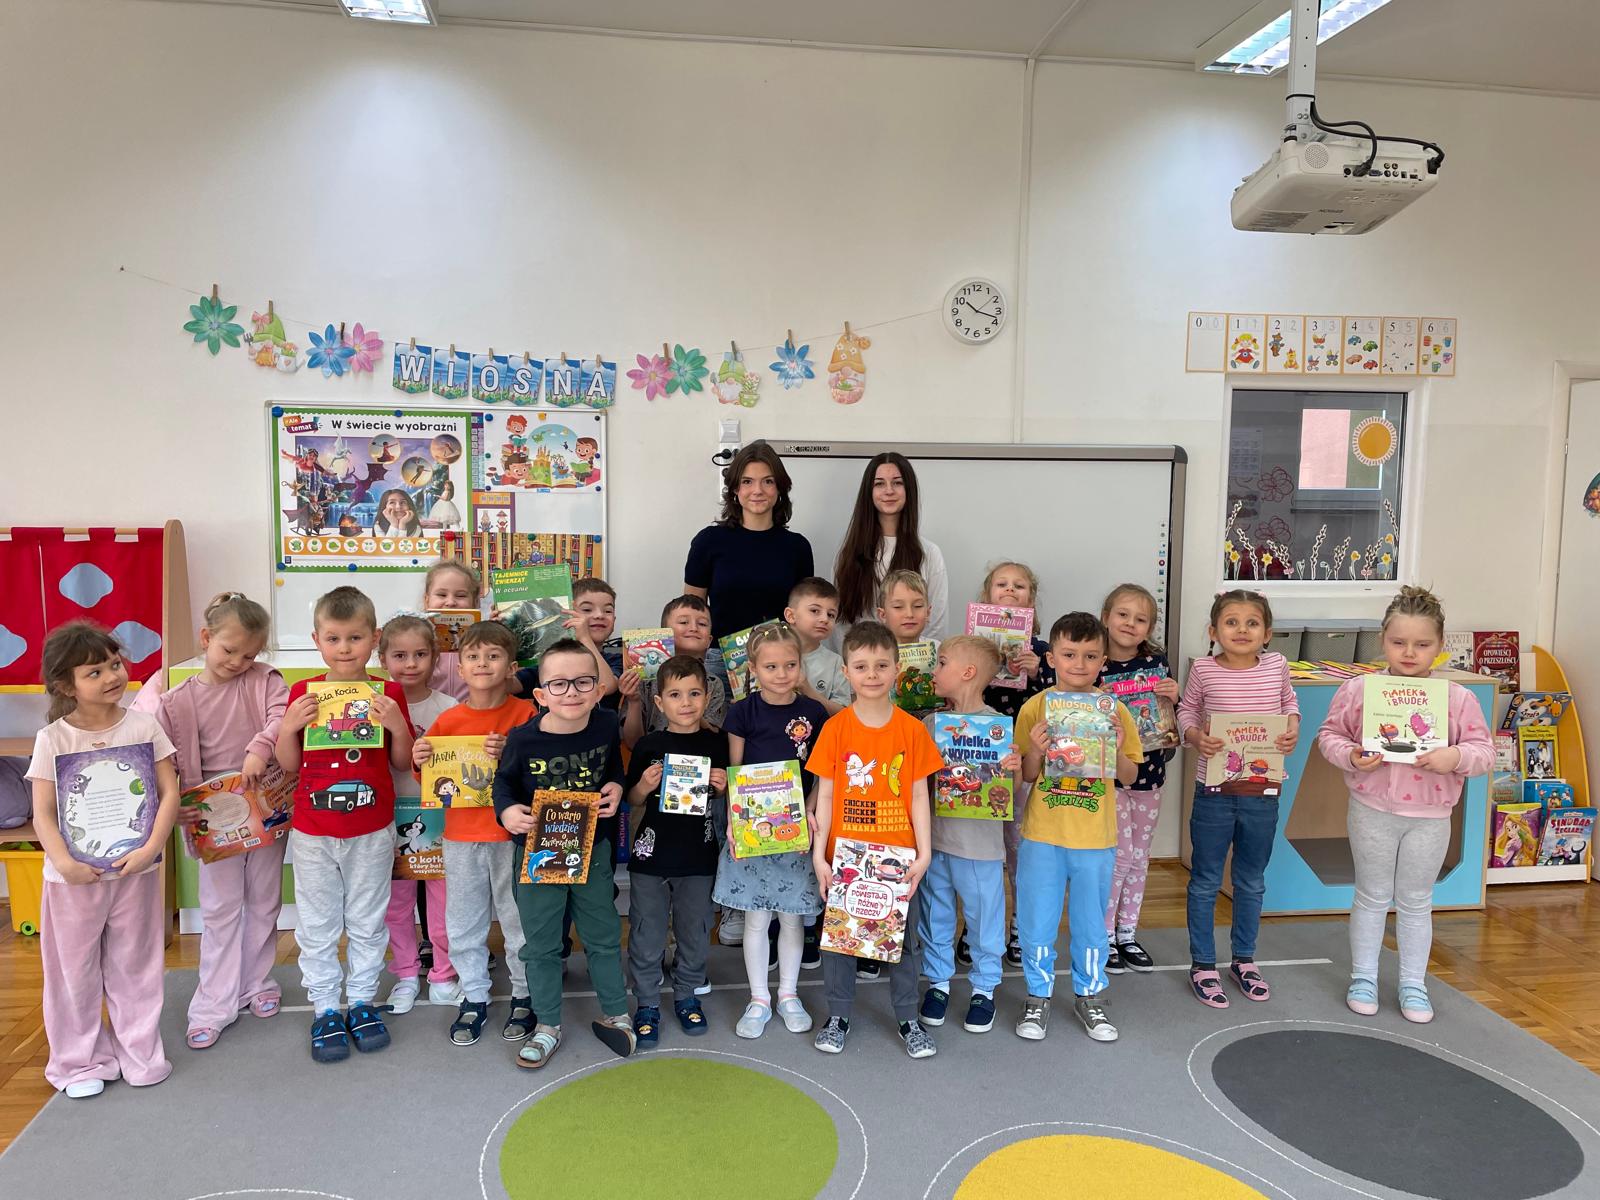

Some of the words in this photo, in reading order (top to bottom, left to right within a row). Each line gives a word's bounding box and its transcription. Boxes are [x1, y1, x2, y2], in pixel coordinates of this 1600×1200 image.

[972, 284, 982, 292] 12
[986, 287, 990, 295] 1
[955, 297, 965, 305] 10
[992, 295, 999, 304] 2
[951, 307, 959, 315] 9
[994, 307, 1002, 315] 3
[955, 318, 962, 327] 8
[991, 318, 999, 326] 4
[1195, 317, 1203, 328] 0
[1235, 318, 1240, 329] 1
[1274, 319, 1281, 330] 2
[1312, 320, 1318, 331] 3
[1351, 321, 1358, 332] 4
[1389, 321, 1396, 332] 5
[1427, 322, 1434, 332] 6
[964, 327, 970, 335] 7
[973, 329, 981, 338] 6
[984, 327, 991, 335] 5
[291, 424, 312, 432] temat
[331, 419, 343, 429] W
[346, 420, 391, 430] świecie
[494, 570, 529, 578] TAJEMNICE
[495, 577, 526, 585] ZWIERZĄT
[979, 614, 1022, 627] Martynka
[1483, 648, 1512, 657] OPOWIEŚCI
[316, 693, 334, 704] icia
[334, 686, 359, 697] Kocia
[1048, 698, 1094, 713] Wiosna
[1391, 696, 1429, 706] BRUDEK
[951, 734, 991, 748] Wielka
[1235, 734, 1268, 744] BRUDEK
[428, 750, 457, 768] JADZIA
[528, 743, 609, 775] DON'T
[948, 748, 998, 762] wyprawa
[263, 769, 285, 789] TUWIM
[843, 798, 876, 808] CHICKEN
[1042, 793, 1100, 812] TURTLES
[545, 808, 557, 822] Co
[558, 810, 582, 824] warto
[843, 807, 876, 816] CHICKEN
[843, 815, 876, 825] CHICKEN
[544, 820, 579, 834] wiedzieć
[842, 823, 876, 832] BANANA
[877, 824, 910, 832] BANANA
[540, 836, 579, 849] Zwierzętach
[408, 856, 417, 864] O
[419, 855, 444, 864] kotk
[409, 863, 430, 871] który
